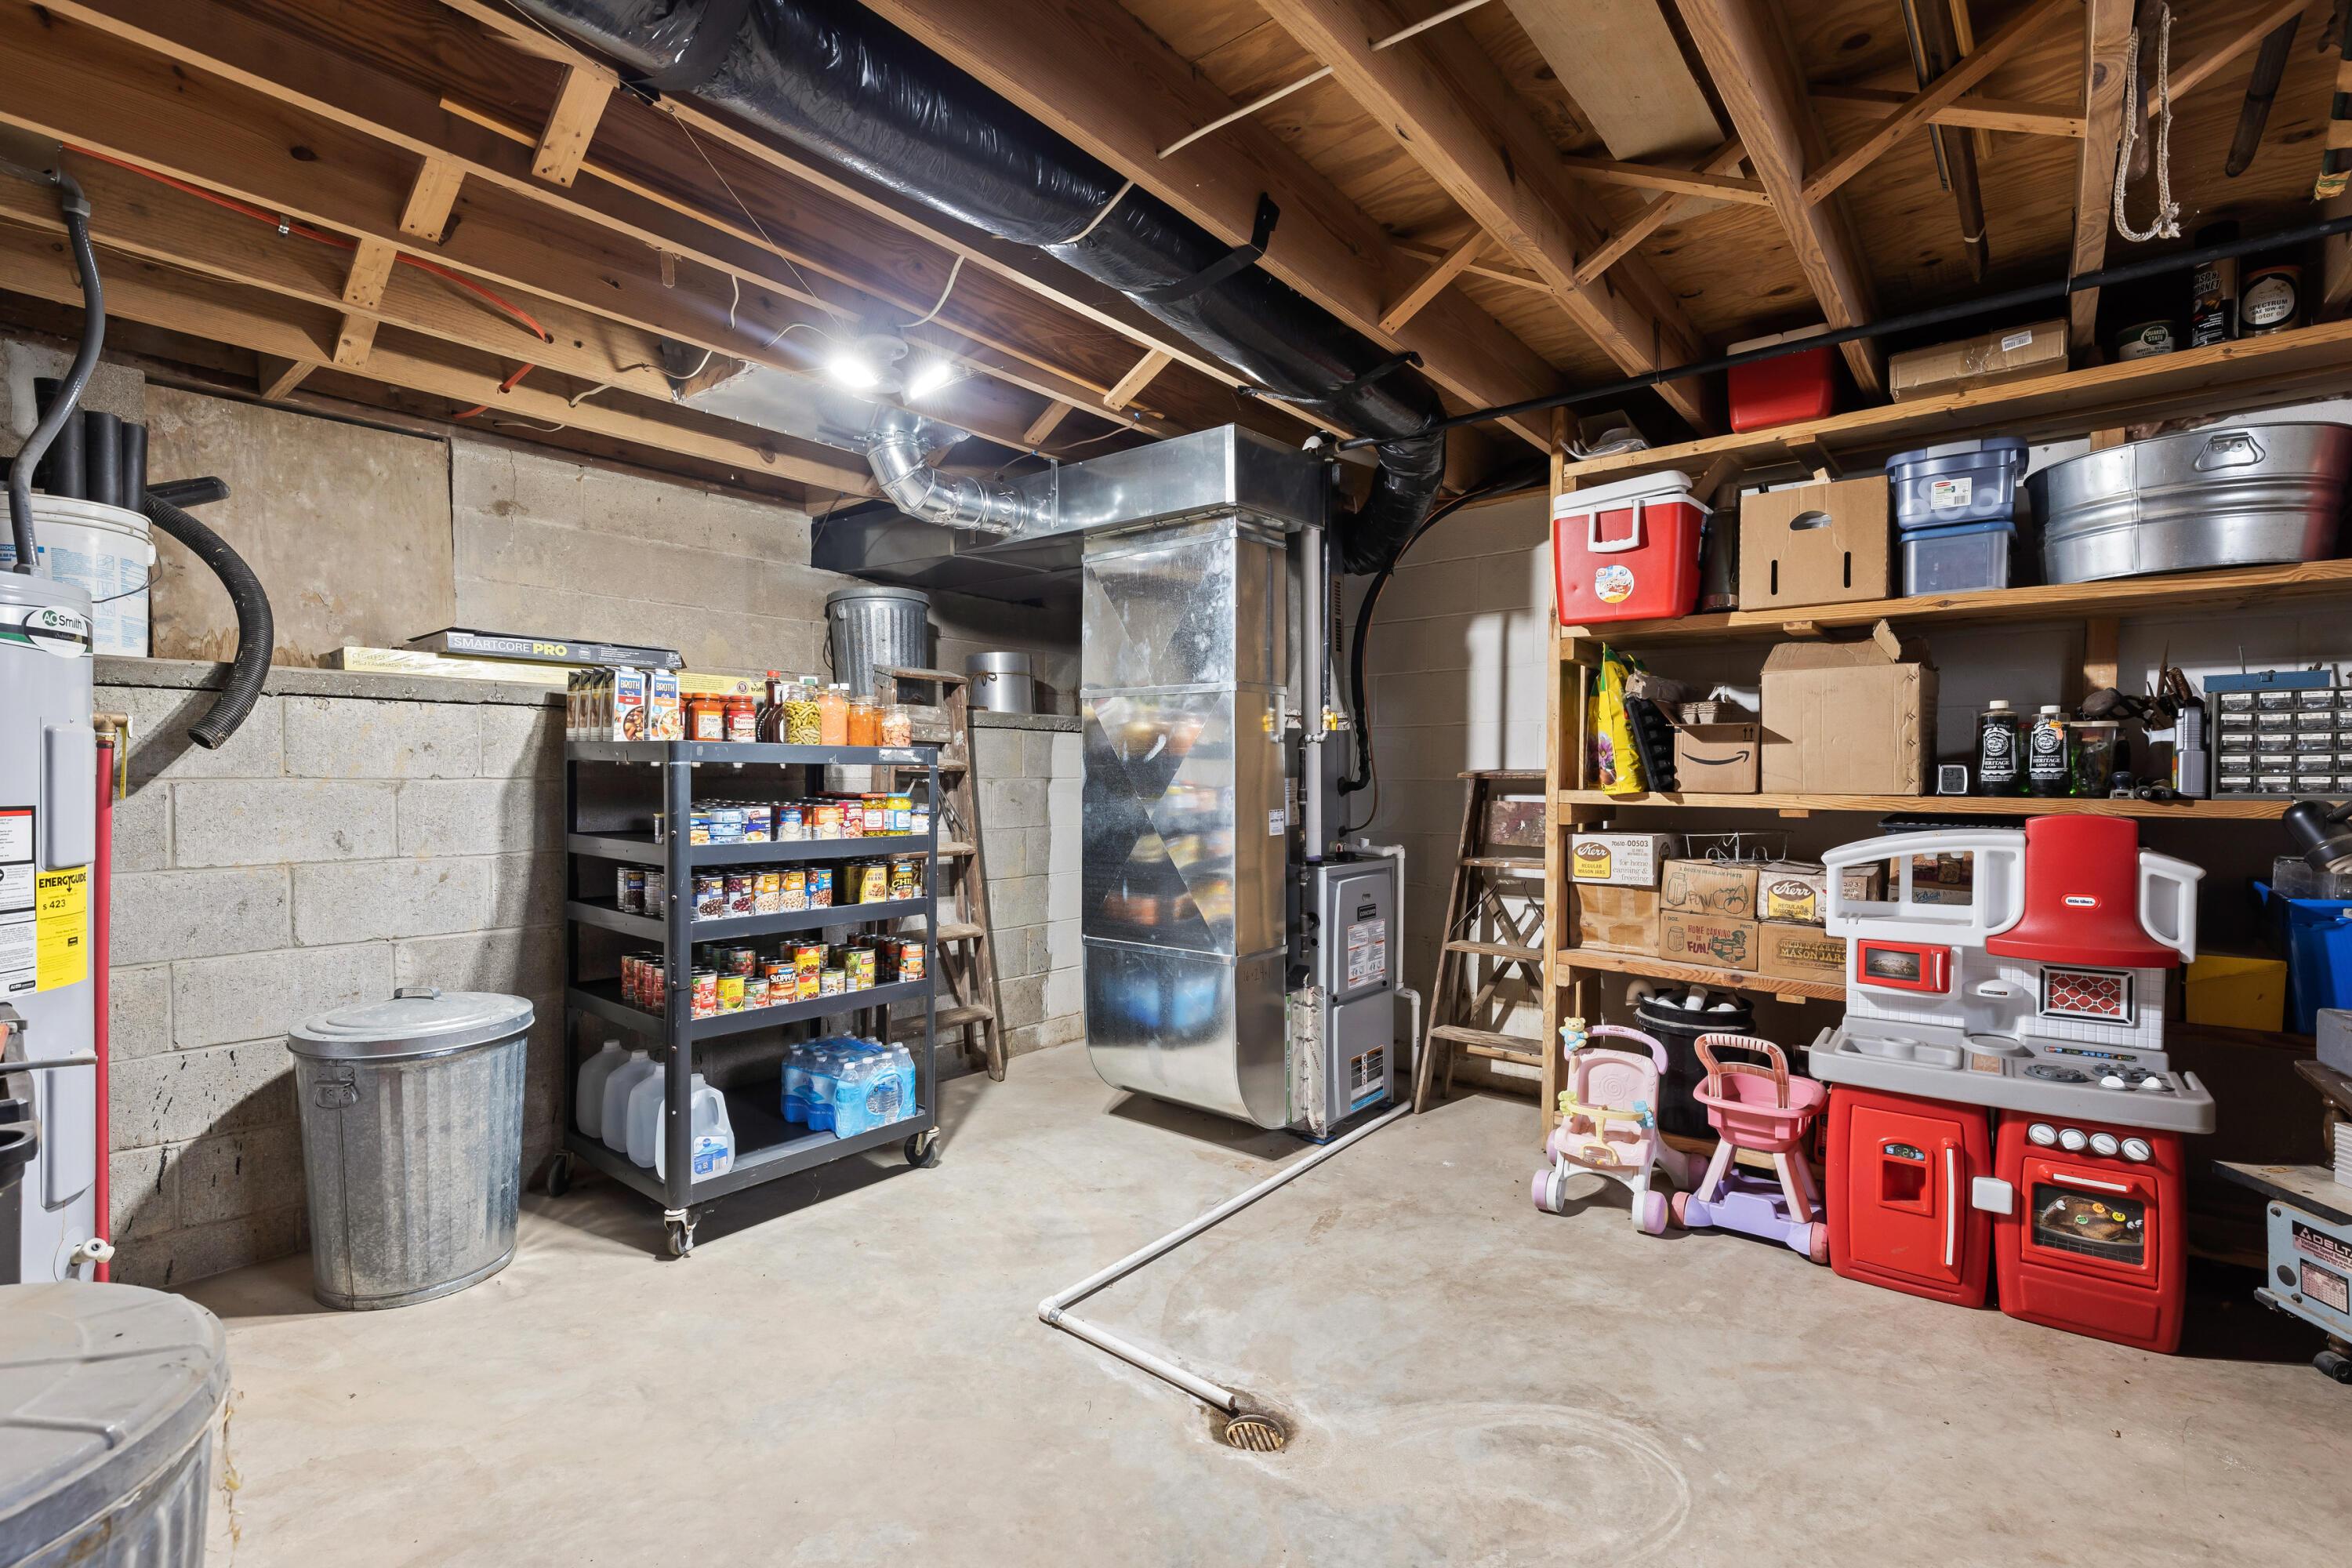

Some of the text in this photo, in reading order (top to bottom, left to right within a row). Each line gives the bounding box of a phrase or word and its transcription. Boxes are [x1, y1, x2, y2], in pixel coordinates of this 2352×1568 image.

[2249, 298, 2288, 312] SPECTRUM
[2251, 312, 2274, 321] motor
[2145, 328, 2165, 337] QUAKER
[454, 637, 531, 652] SMARTCORE
[532, 642, 568, 657] PRO
[620, 679, 640, 690] BROTH
[655, 682, 675, 693] BROTH
[1577, 843, 1608, 856] Kerr
[38, 872, 86, 892] ENERGYGUIDE
[1621, 874, 1650, 883] freezing
[1773, 881, 1811, 896] Kerr
[49, 898, 66, 909] 423
[1688, 924, 1731, 938] HOME CANNING
[1686, 939, 1711, 955] FUN!
[1780, 947, 1818, 960] MASON
[1812, 942, 1846, 953] HARVES
[770, 973, 789, 982] SLOPPY
[2301, 1238, 2319, 1251] Variable
[2319, 1244, 2334, 1258] Speed
[2335, 1252, 2349, 1264] Bench
[2313, 1233, 2352, 1261] DELT
